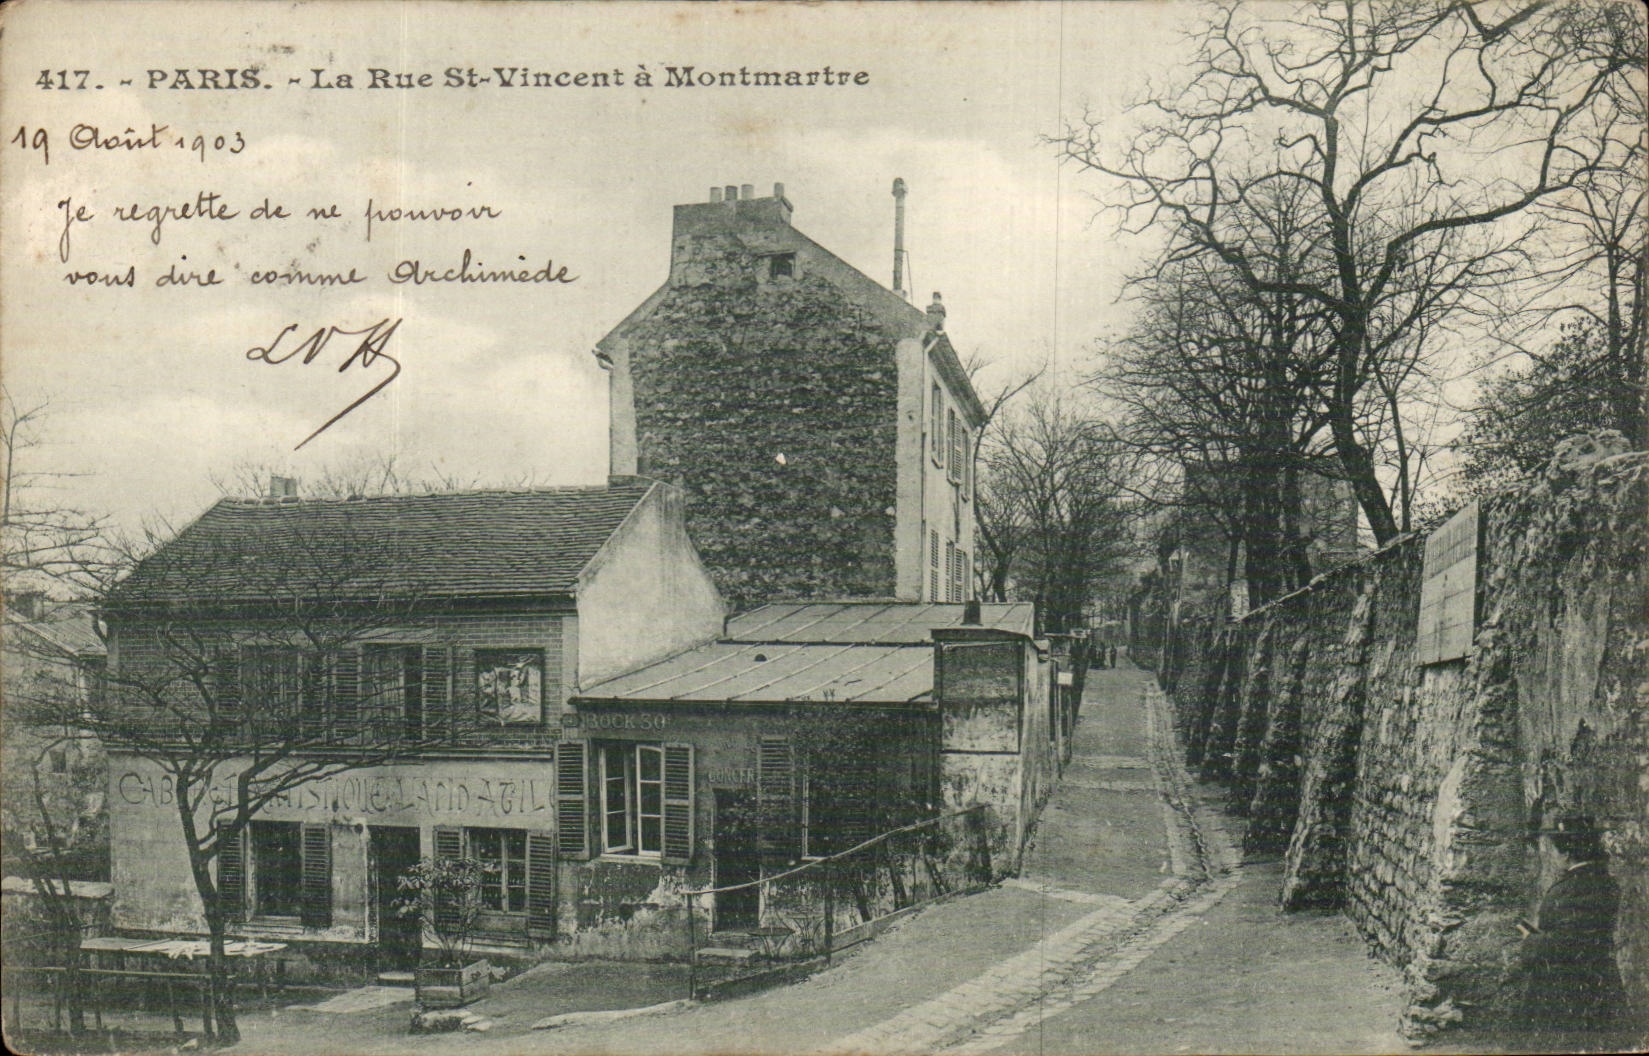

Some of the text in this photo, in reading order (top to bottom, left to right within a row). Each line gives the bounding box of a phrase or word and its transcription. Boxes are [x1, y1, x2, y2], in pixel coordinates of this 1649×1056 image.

[11, 123, 246, 165] 19 Août 1903
[57, 181, 503, 263] Je regrette de ne pouvoir
[64, 264, 136, 288] vous
[155, 254, 225, 287] dire
[250, 268, 368, 286] comme
